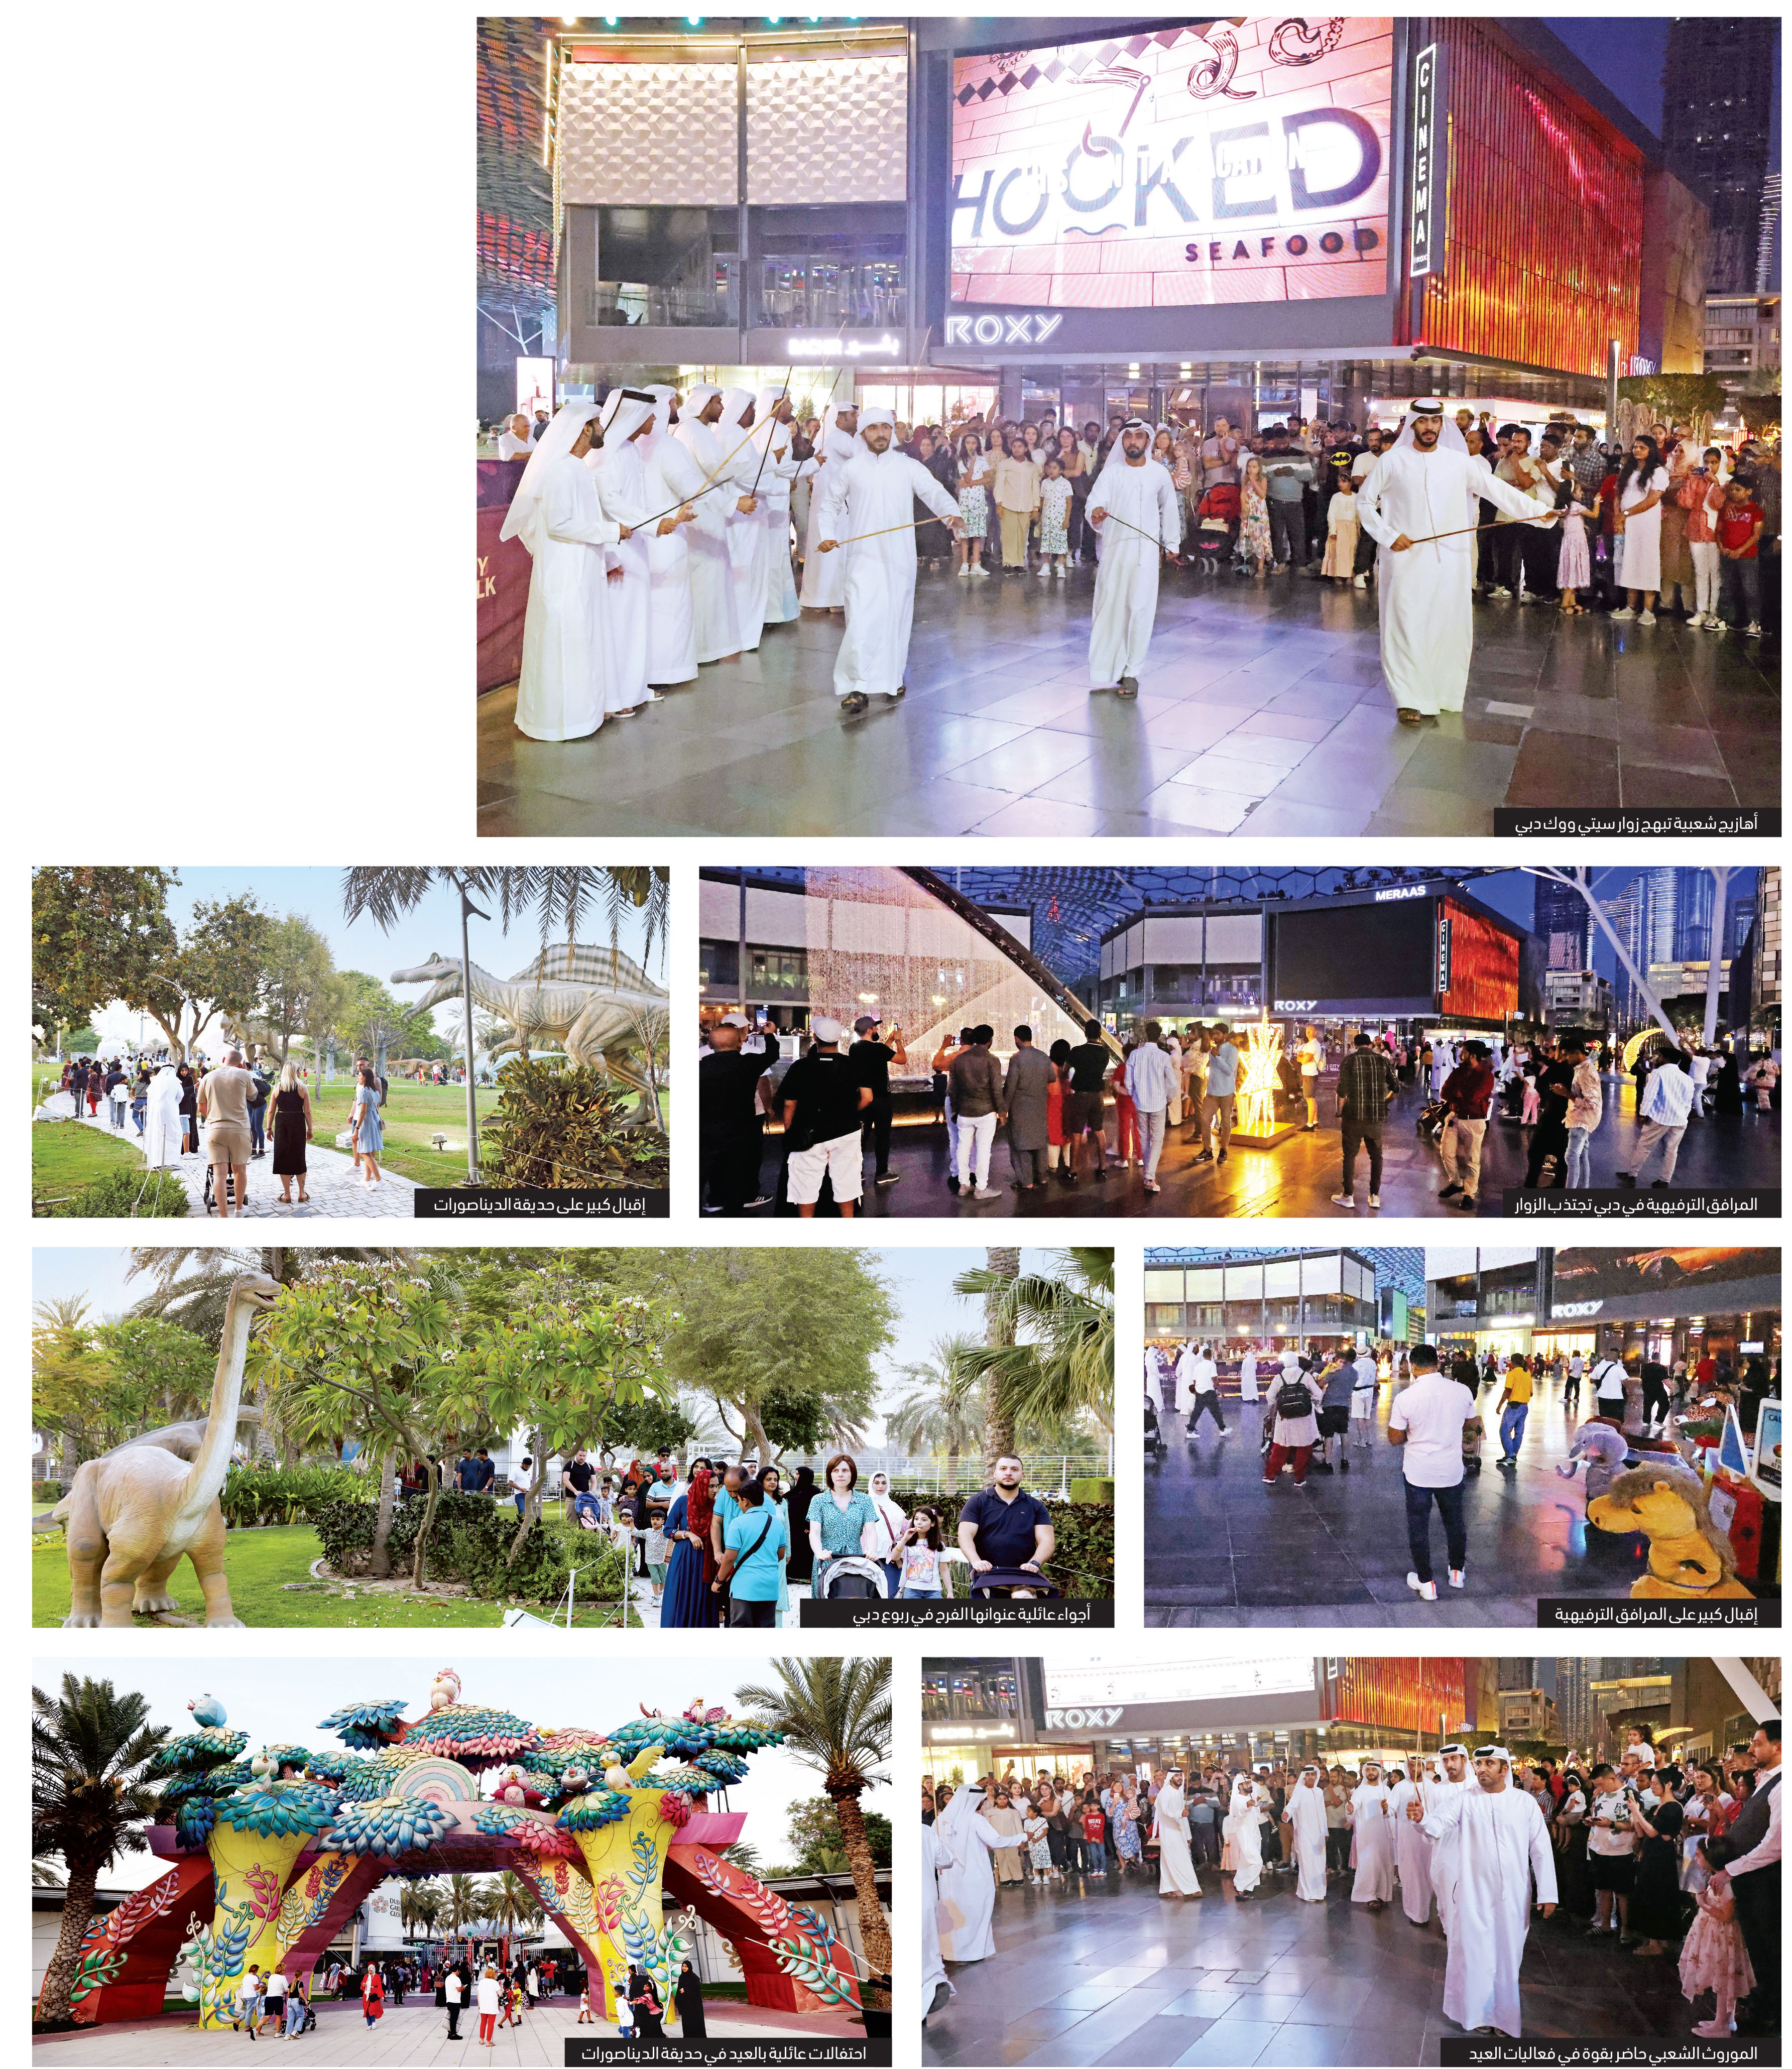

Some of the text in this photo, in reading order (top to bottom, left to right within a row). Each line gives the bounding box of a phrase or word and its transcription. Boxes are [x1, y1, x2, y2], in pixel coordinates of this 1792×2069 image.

[1416, 62, 1429, 245] CINEMA
[952, 107, 1381, 237] HOOKED
[1185, 227, 1379, 262] SEAFOOD
[947, 314, 1062, 343] ROXY
[1376, 886, 1426, 901] MERAAS
[1274, 1000, 1318, 1011] ROXY
[1551, 1300, 1603, 1318] ROXY
[1046, 1707, 1123, 1729] ROXY
